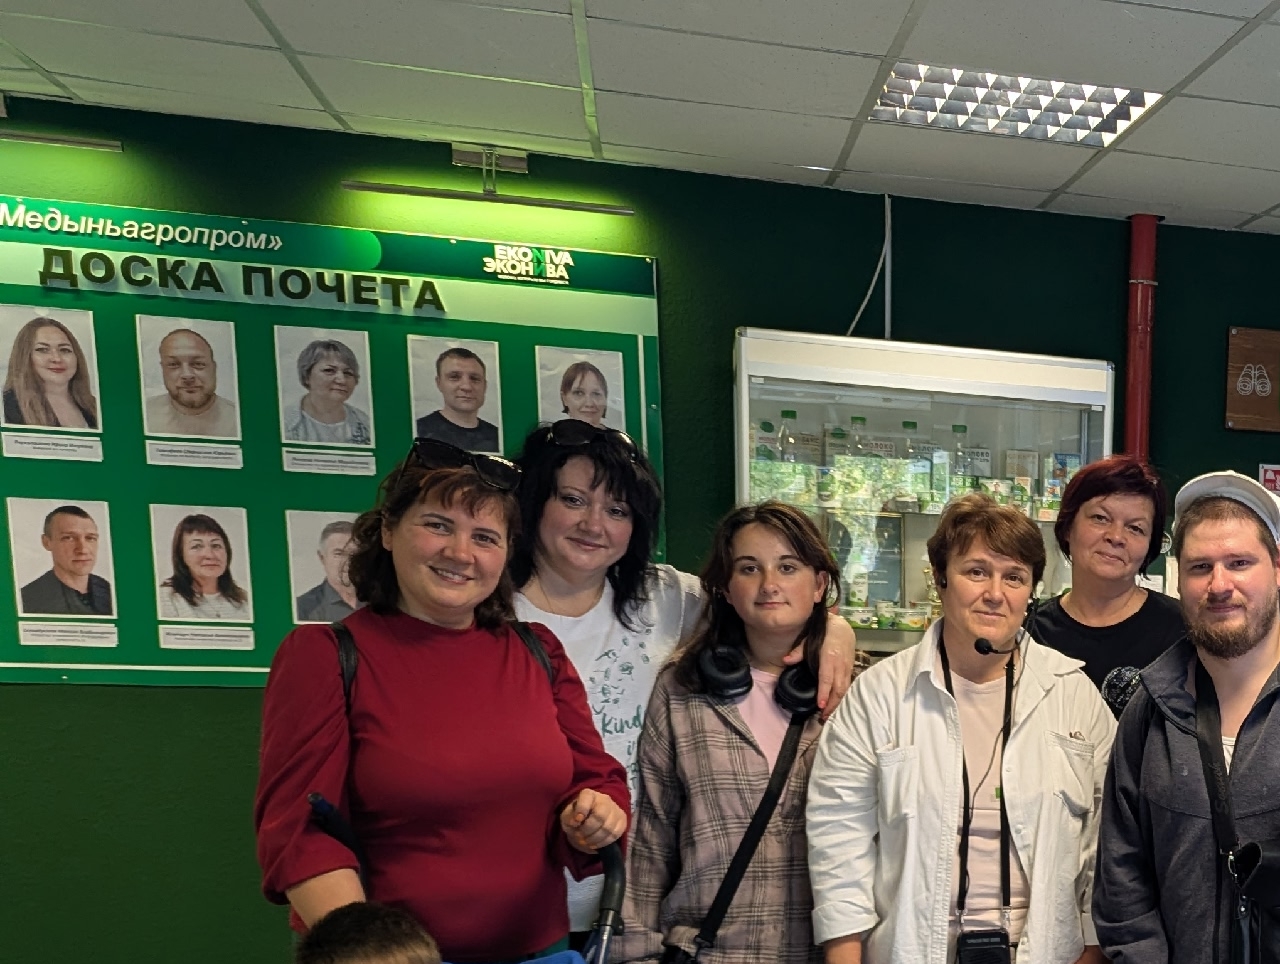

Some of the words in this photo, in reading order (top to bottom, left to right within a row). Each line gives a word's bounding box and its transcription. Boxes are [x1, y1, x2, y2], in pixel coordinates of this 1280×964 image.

[0, 203, 283, 251] Медыньагропром»
[482, 257, 570, 280] ЭКОНИВА
[493, 244, 575, 267] EKONIVA
[38, 248, 225, 294] ДОСКА
[242, 264, 446, 313] ПОЧЕТА
